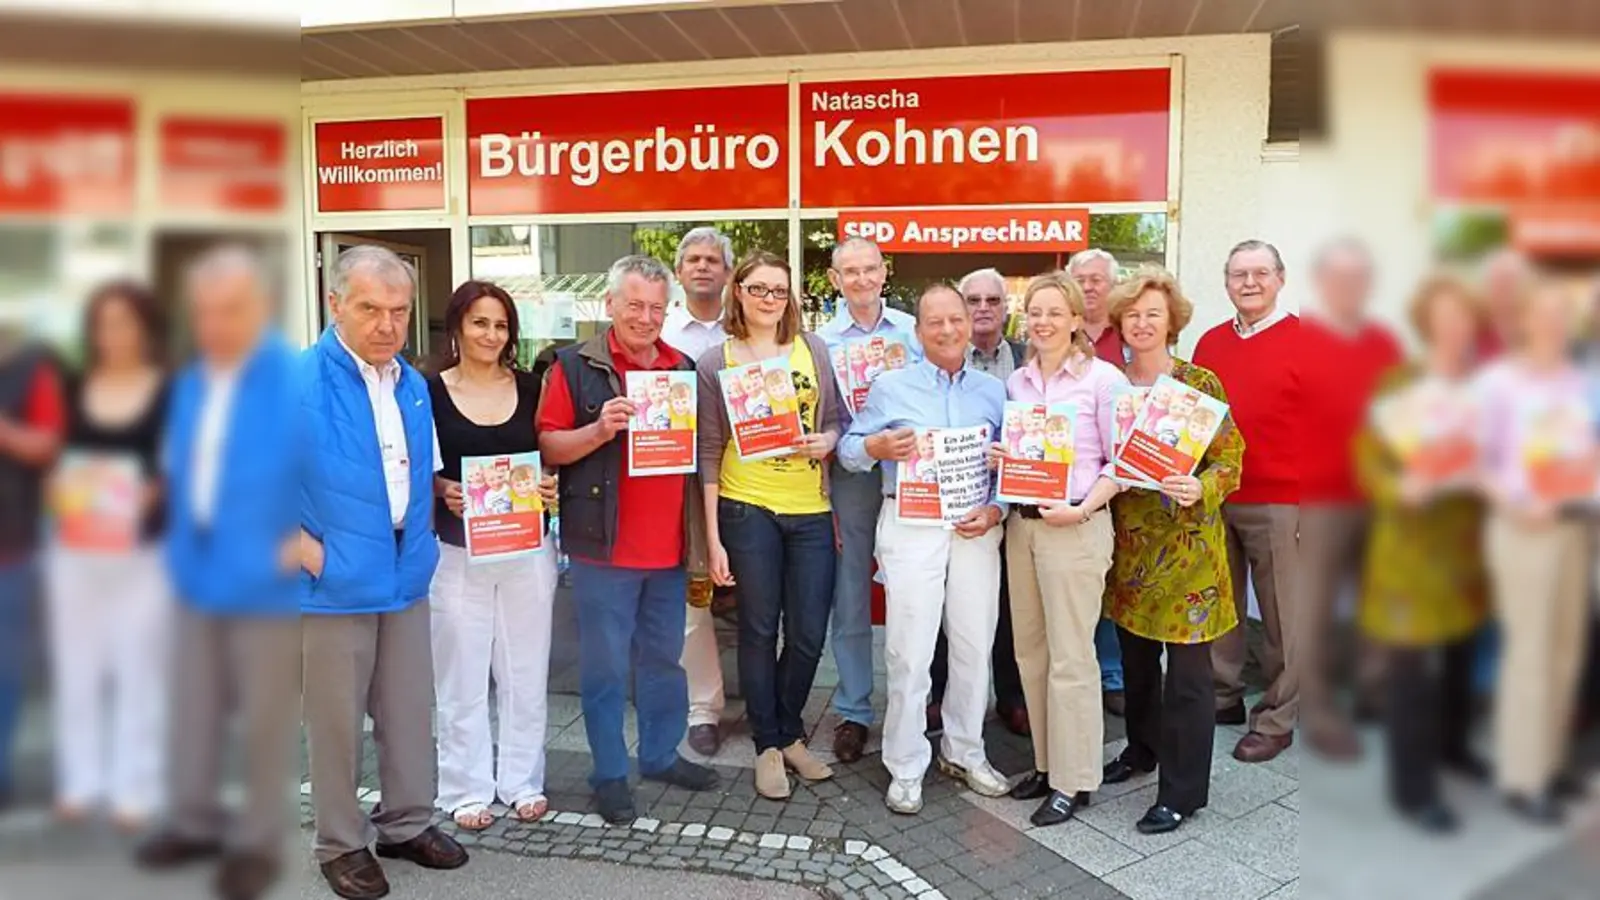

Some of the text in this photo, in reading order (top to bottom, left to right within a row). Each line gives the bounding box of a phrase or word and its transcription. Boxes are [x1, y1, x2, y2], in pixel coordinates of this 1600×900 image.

[812, 88, 920, 111] Natascha
[341, 139, 419, 160] Herzlich
[480, 124, 779, 187] Bürgerbüro
[814, 118, 1039, 168] Kohnen
[318, 161, 443, 184] Willkommen!
[844, 219, 1083, 248] SPD AnsprechBAR
